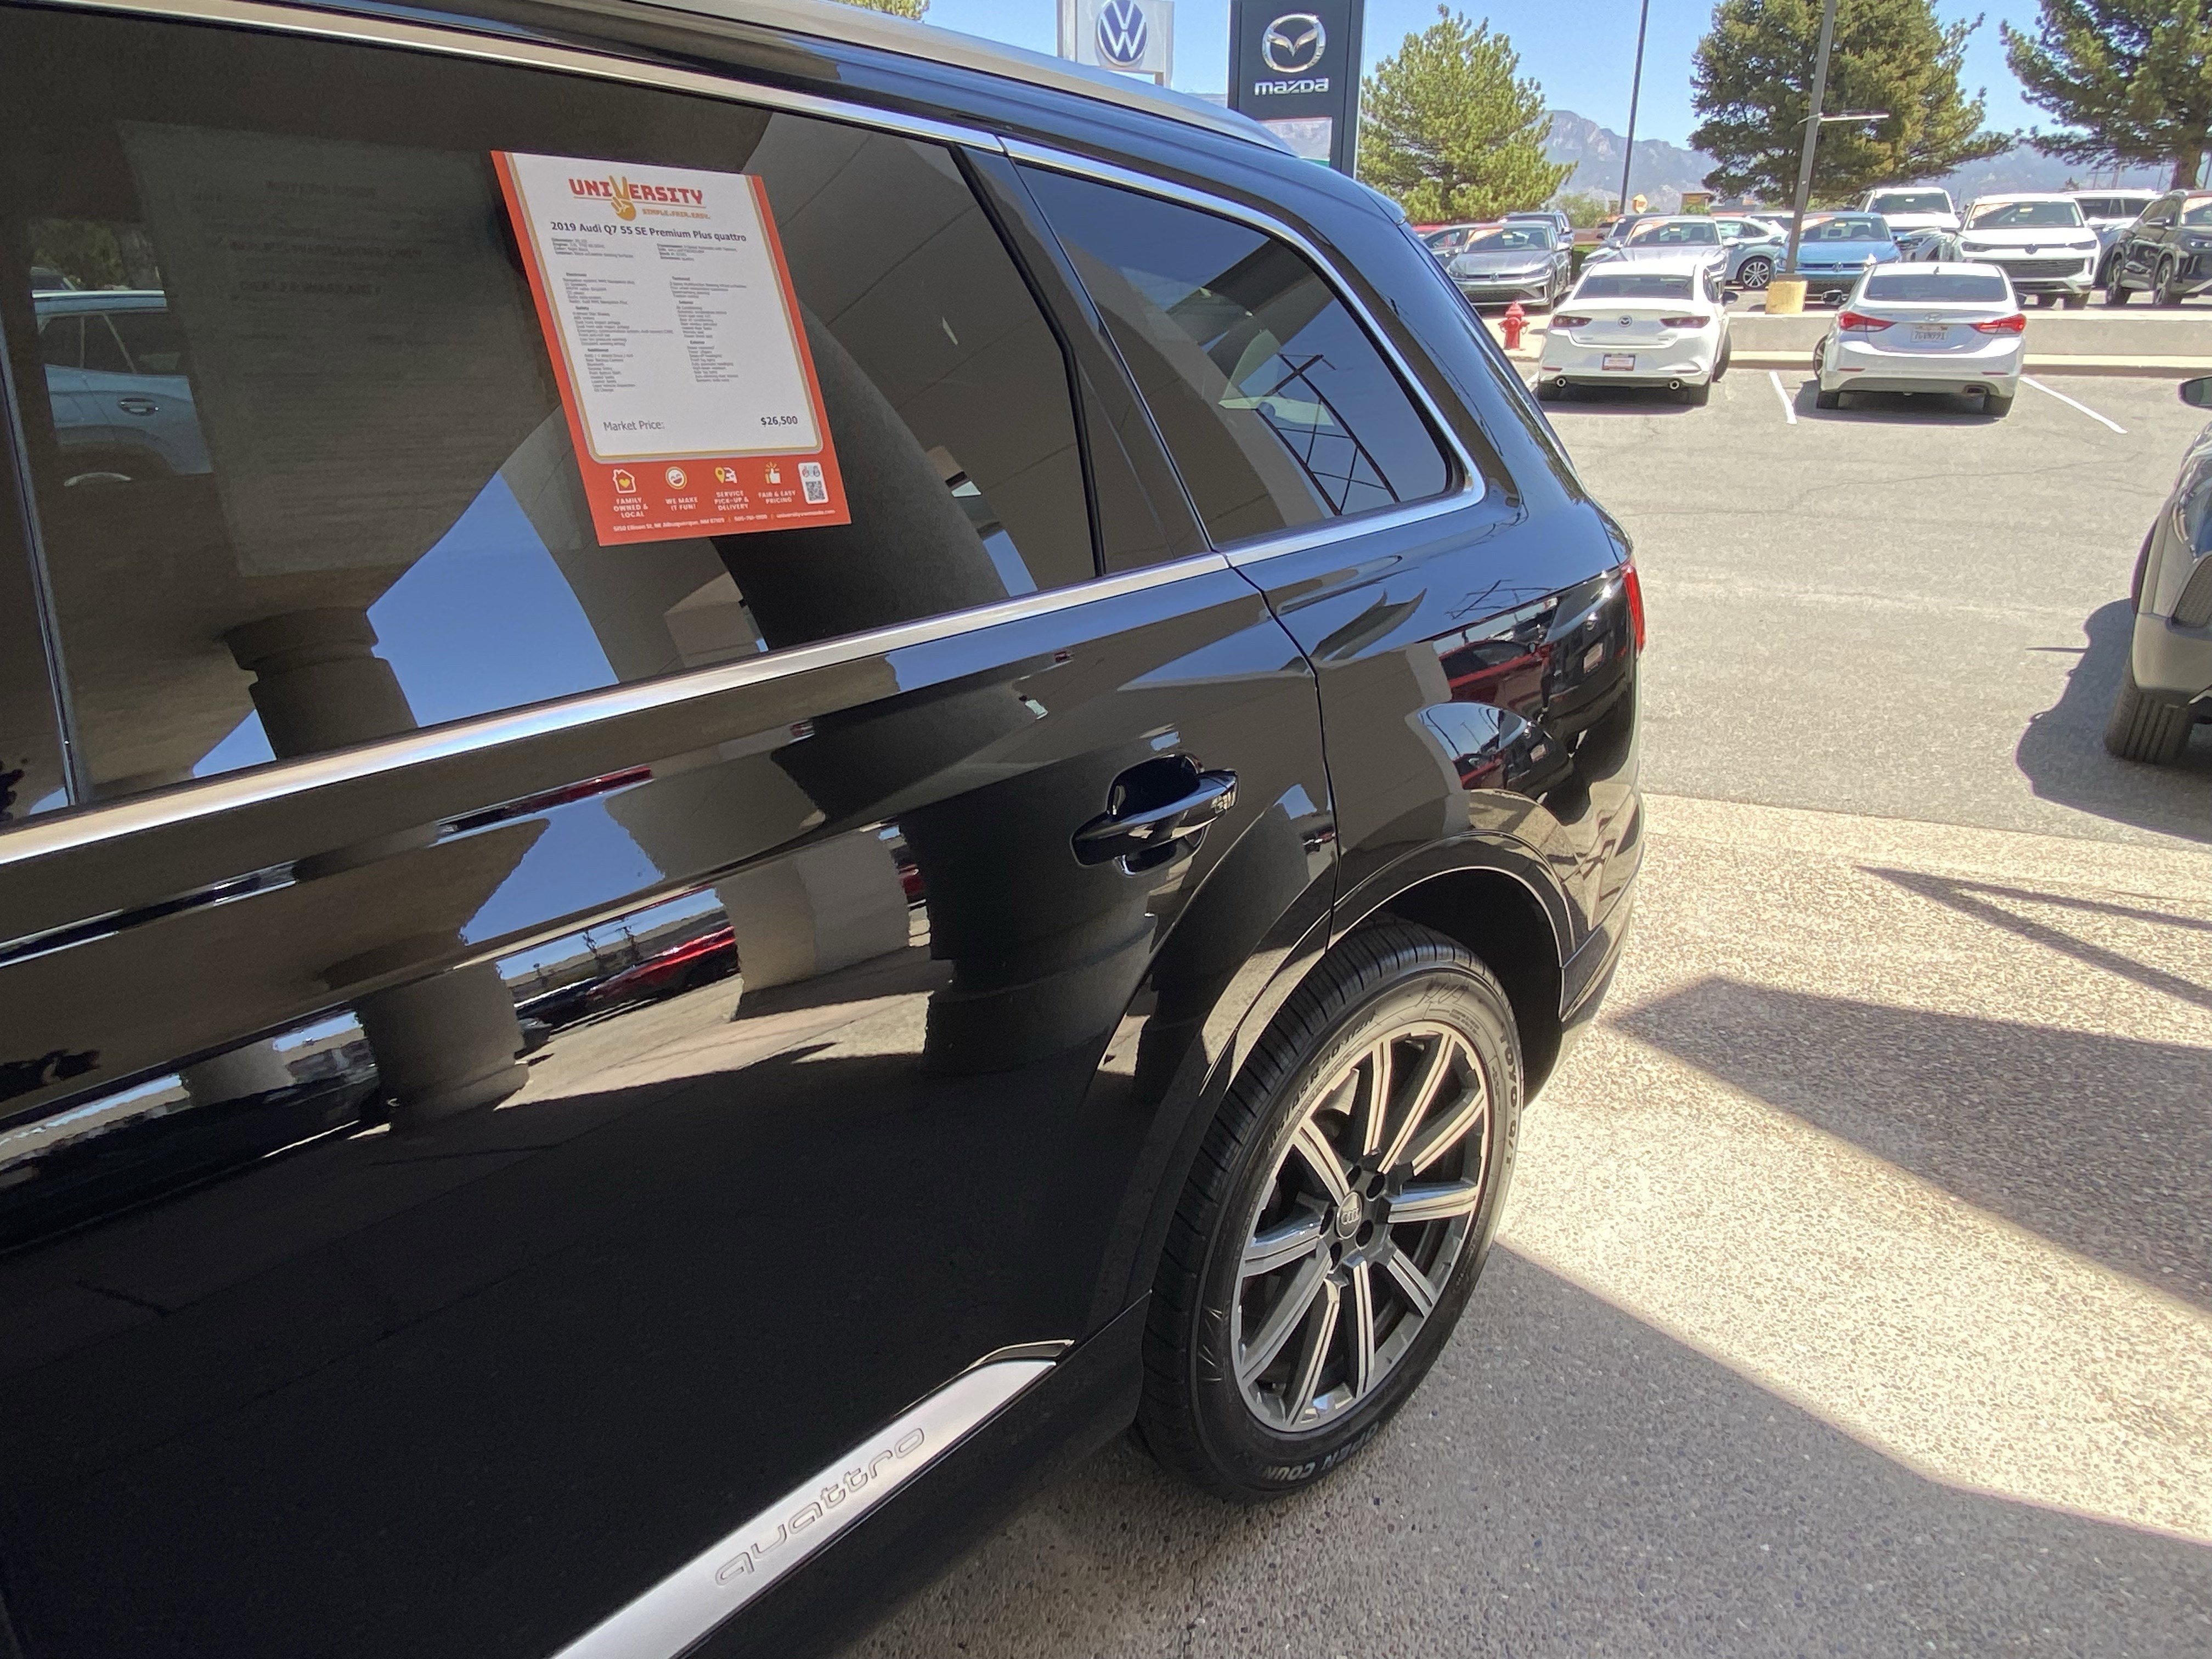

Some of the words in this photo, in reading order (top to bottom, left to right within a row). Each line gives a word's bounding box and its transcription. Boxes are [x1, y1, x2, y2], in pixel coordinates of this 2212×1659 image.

[568, 175, 703, 206] UNIVERSITY
[551, 221, 577, 232] 2019
[579, 224, 602, 233] Audi
[604, 225, 617, 235] Q7
[620, 227, 633, 235] 55
[635, 227, 648, 236] SE
[650, 228, 691, 239] Premium
[693, 231, 712, 240] Plus
[714, 232, 747, 242] quattro
[603, 420, 636, 431] Market
[639, 420, 664, 430] Price:
[761, 416, 798, 427] $26,500
[1500, 1034, 1517, 1108] TOYO
[715, 1427, 925, 1587] quattro
